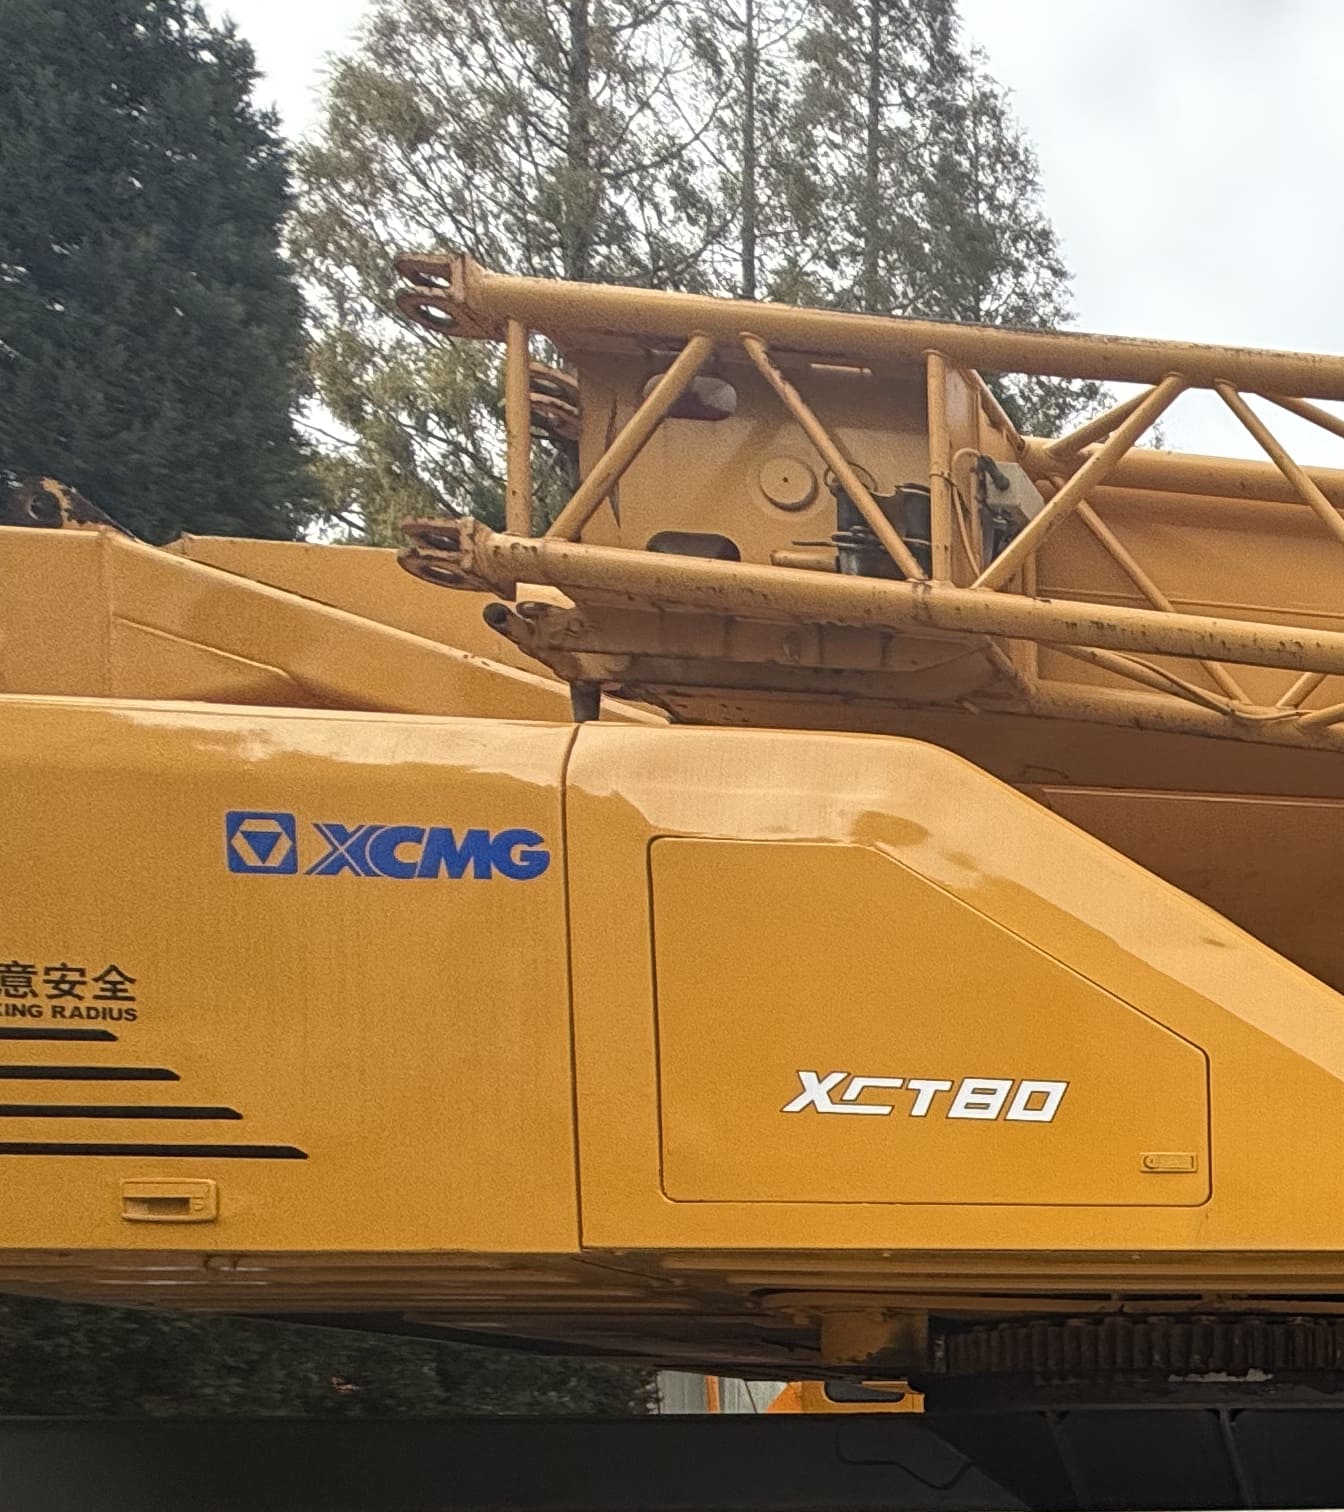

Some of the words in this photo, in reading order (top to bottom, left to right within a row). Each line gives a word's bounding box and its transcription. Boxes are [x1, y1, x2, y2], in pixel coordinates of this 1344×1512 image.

[303, 822, 551, 881] XCMG
[0, 960, 137, 1002] 意安全
[0, 1002, 44, 1019] ING
[51, 1004, 138, 1021] RADIUS
[779, 1069, 1070, 1123] XCT80
